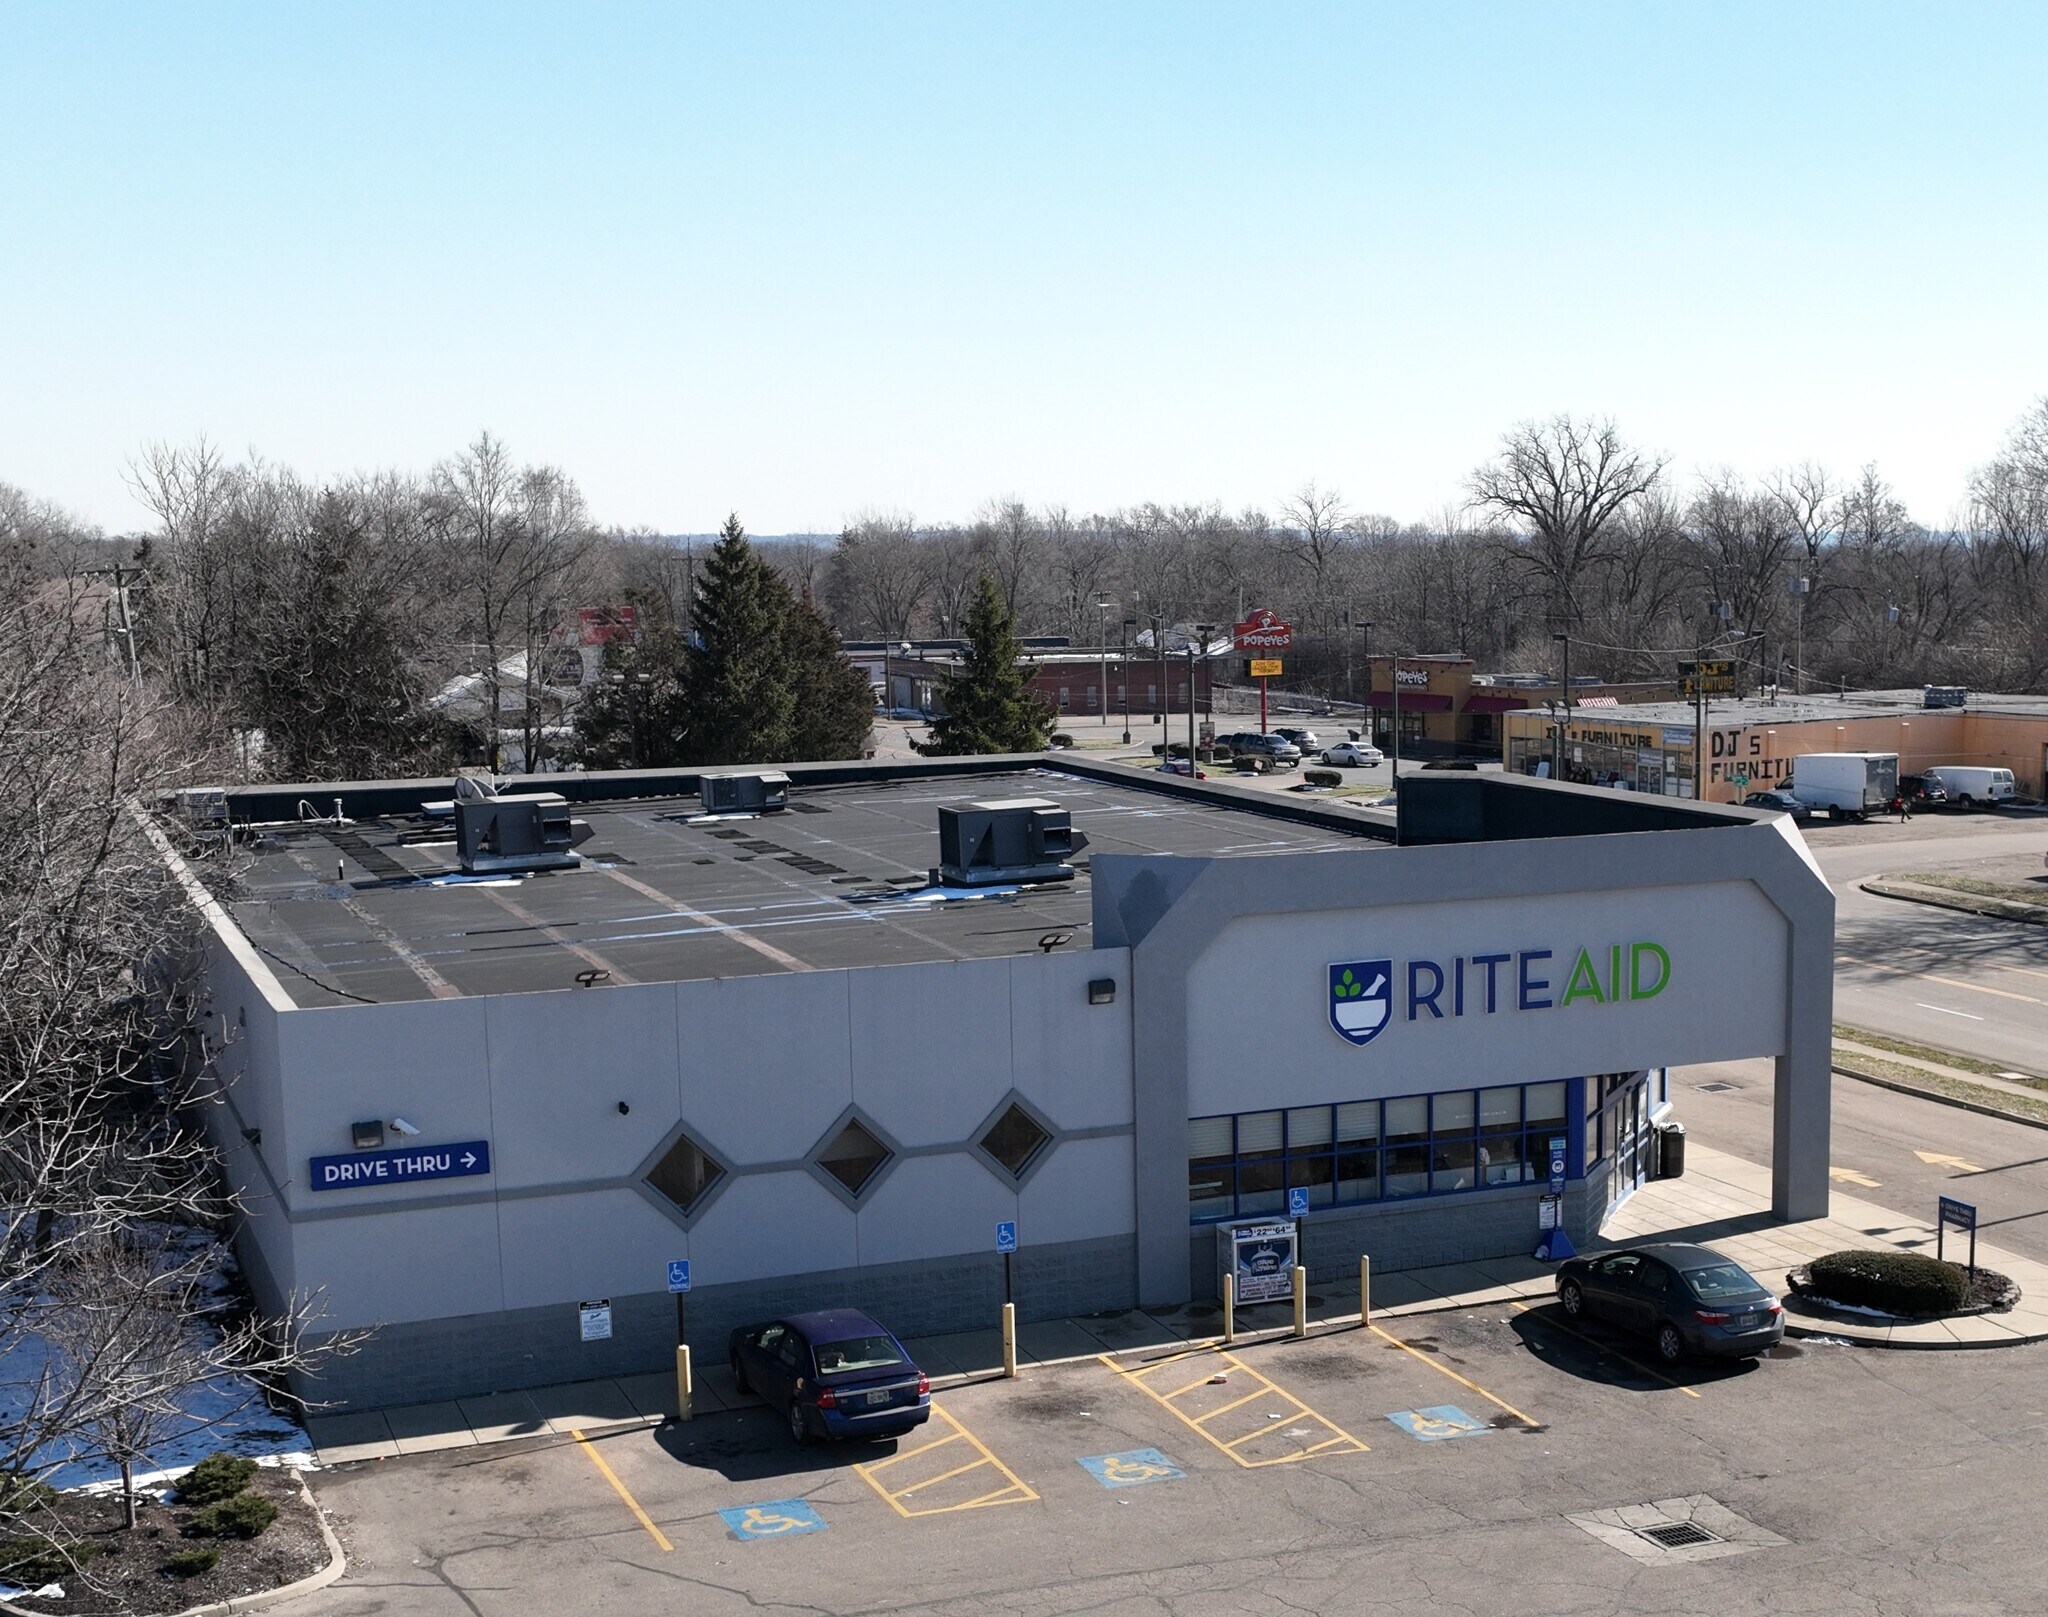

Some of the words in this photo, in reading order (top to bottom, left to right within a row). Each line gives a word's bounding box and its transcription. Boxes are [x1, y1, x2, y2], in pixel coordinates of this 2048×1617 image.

[1582, 730, 1652, 747] FURNITURE
[1711, 758, 1794, 783] FURNITU
[1405, 950, 1553, 1021] RITE
[1561, 941, 1672, 1008] AID
[324, 1160, 389, 1182] DRIVE
[393, 1153, 451, 1175] THRU
